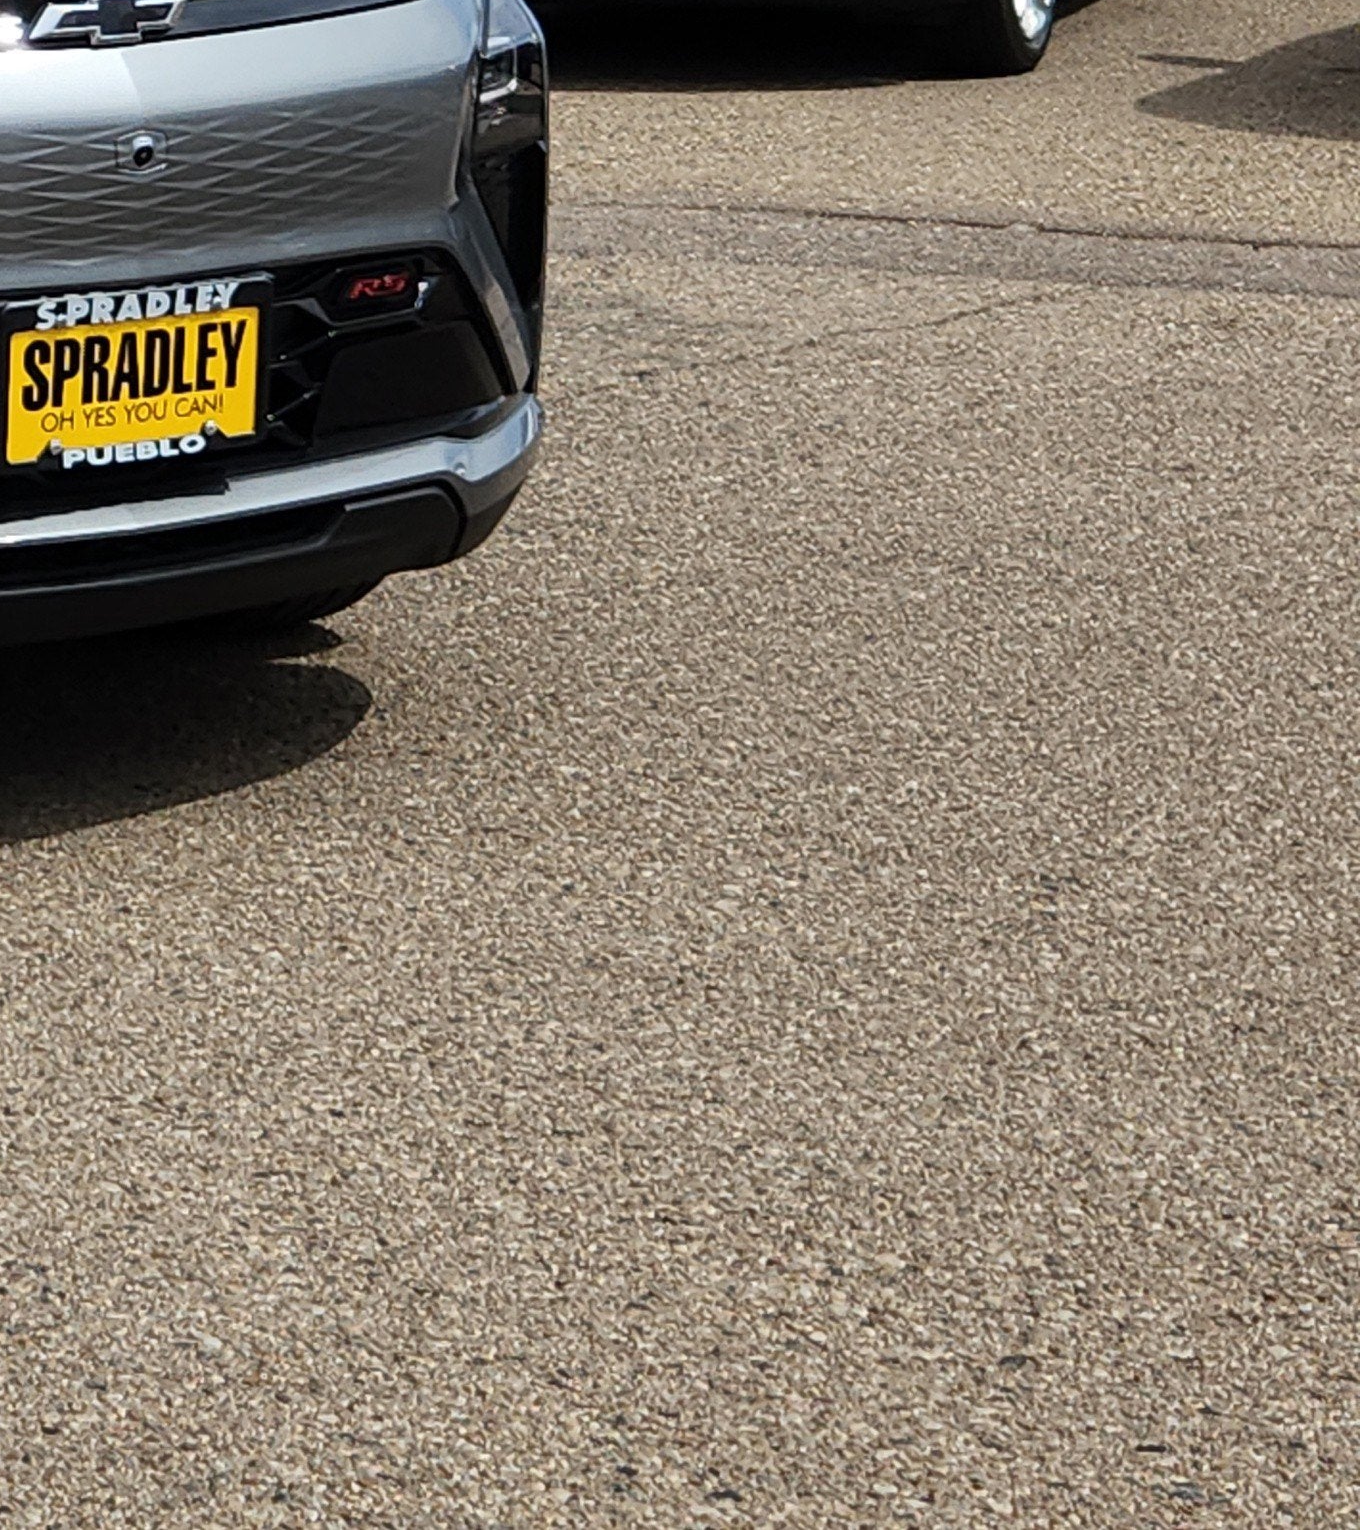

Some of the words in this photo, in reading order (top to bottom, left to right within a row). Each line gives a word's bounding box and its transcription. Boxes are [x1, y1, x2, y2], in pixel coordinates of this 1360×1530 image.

[35, 282, 239, 330] SPRADLEY
[22, 319, 248, 411] SPRADLEY
[41, 411, 74, 432] OH
[83, 405, 116, 428] YES
[124, 400, 167, 424] YOU
[175, 393, 224, 418] CAN!
[63, 433, 206, 469] PUEBLO
